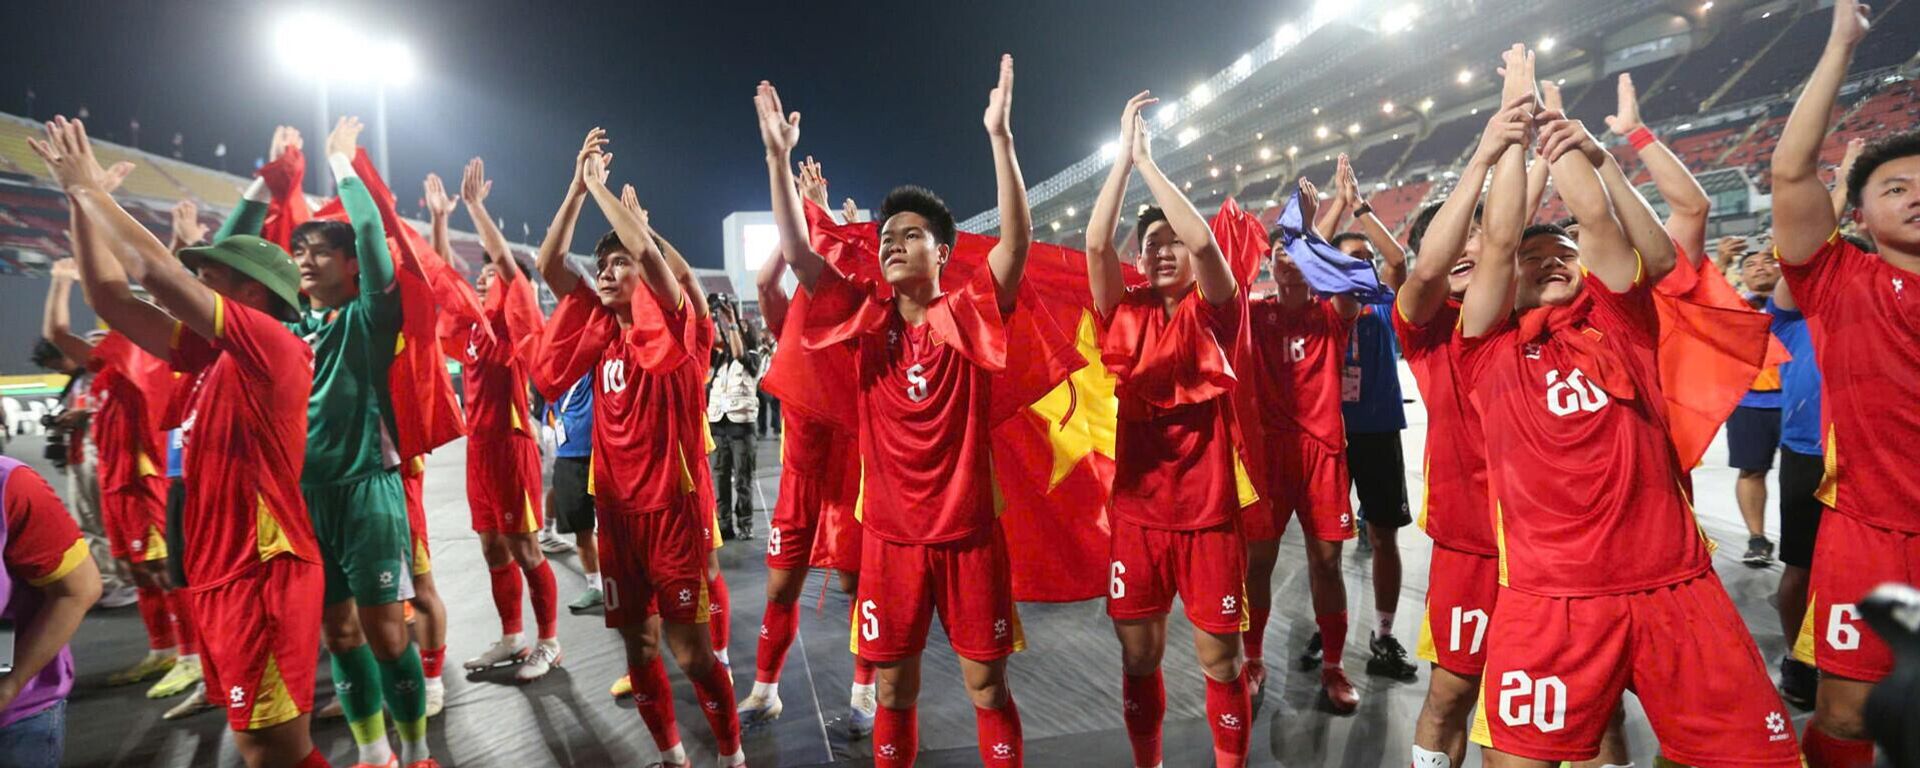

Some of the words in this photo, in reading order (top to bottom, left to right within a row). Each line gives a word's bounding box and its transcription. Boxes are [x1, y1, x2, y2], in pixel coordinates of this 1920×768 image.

[1282, 336, 1305, 363] 18
[603, 358, 626, 394] 10
[906, 363, 928, 403] 5
[1545, 367, 1609, 417] 20
[1110, 560, 1126, 599] 6
[862, 599, 879, 641] 5
[1449, 606, 1489, 655] 17
[1826, 603, 1862, 650] 6
[1498, 669, 1567, 733] 20
